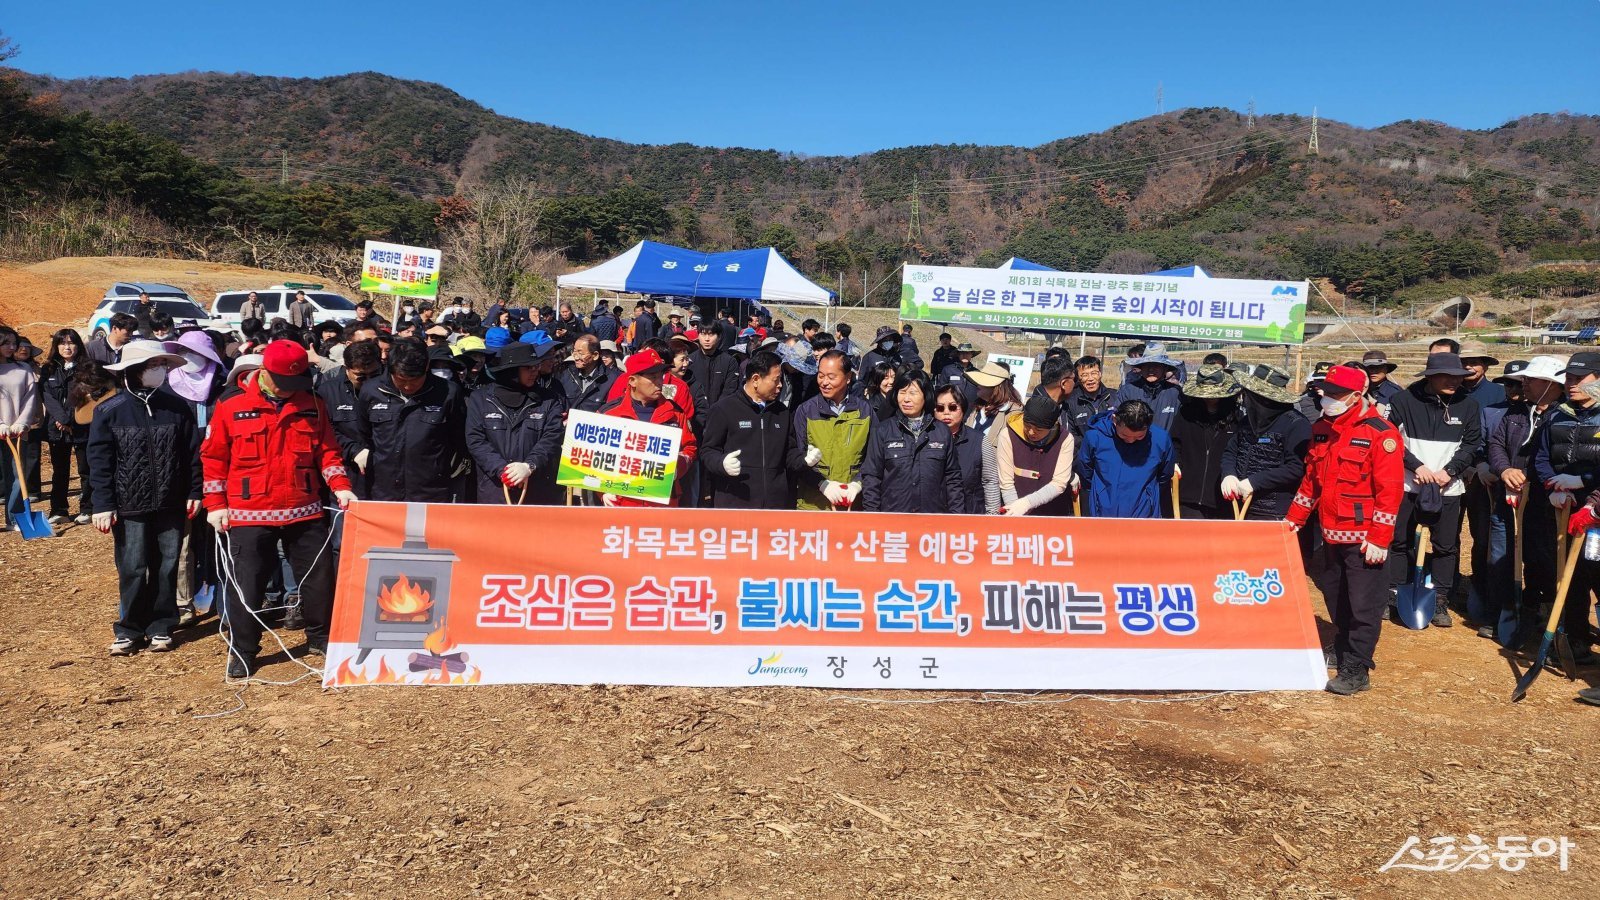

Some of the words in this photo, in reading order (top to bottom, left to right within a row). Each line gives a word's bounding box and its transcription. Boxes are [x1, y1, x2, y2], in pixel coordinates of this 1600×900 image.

[368, 265, 399, 281] 방심하면
[370, 249, 401, 265] 예방하면
[1008, 275, 1042, 287] 제81회
[1045, 277, 1078, 289] 식목일
[1132, 281, 1179, 293] 통합기념
[932, 286, 962, 304] 오늘
[966, 288, 996, 305] 심은
[1001, 289, 1017, 307] 한
[1020, 291, 1069, 310] 그루가
[1073, 294, 1107, 312] 푸른
[1111, 296, 1146, 314] 숲의
[1151, 298, 1204, 318] 시작이
[1209, 301, 1266, 321] 됩니다
[574, 422, 623, 448] 예방하면
[624, 431, 672, 457] 산불제로
[570, 446, 617, 472] 방심하면
[618, 455, 666, 481] 한줌재로
[602, 526, 759, 561] 화목보일러
[919, 531, 978, 566] 예방
[987, 532, 1075, 568] 캠페인
[1215, 569, 1284, 604] 성장장성
[478, 575, 613, 630] 조심은
[626, 577, 724, 633] 습관,
[738, 578, 863, 632] 불씨는
[876, 580, 971, 635] 순간,
[983, 582, 1104, 634] 피해는
[1115, 584, 1198, 635] 평생
[748, 656, 808, 678] Jangseong
